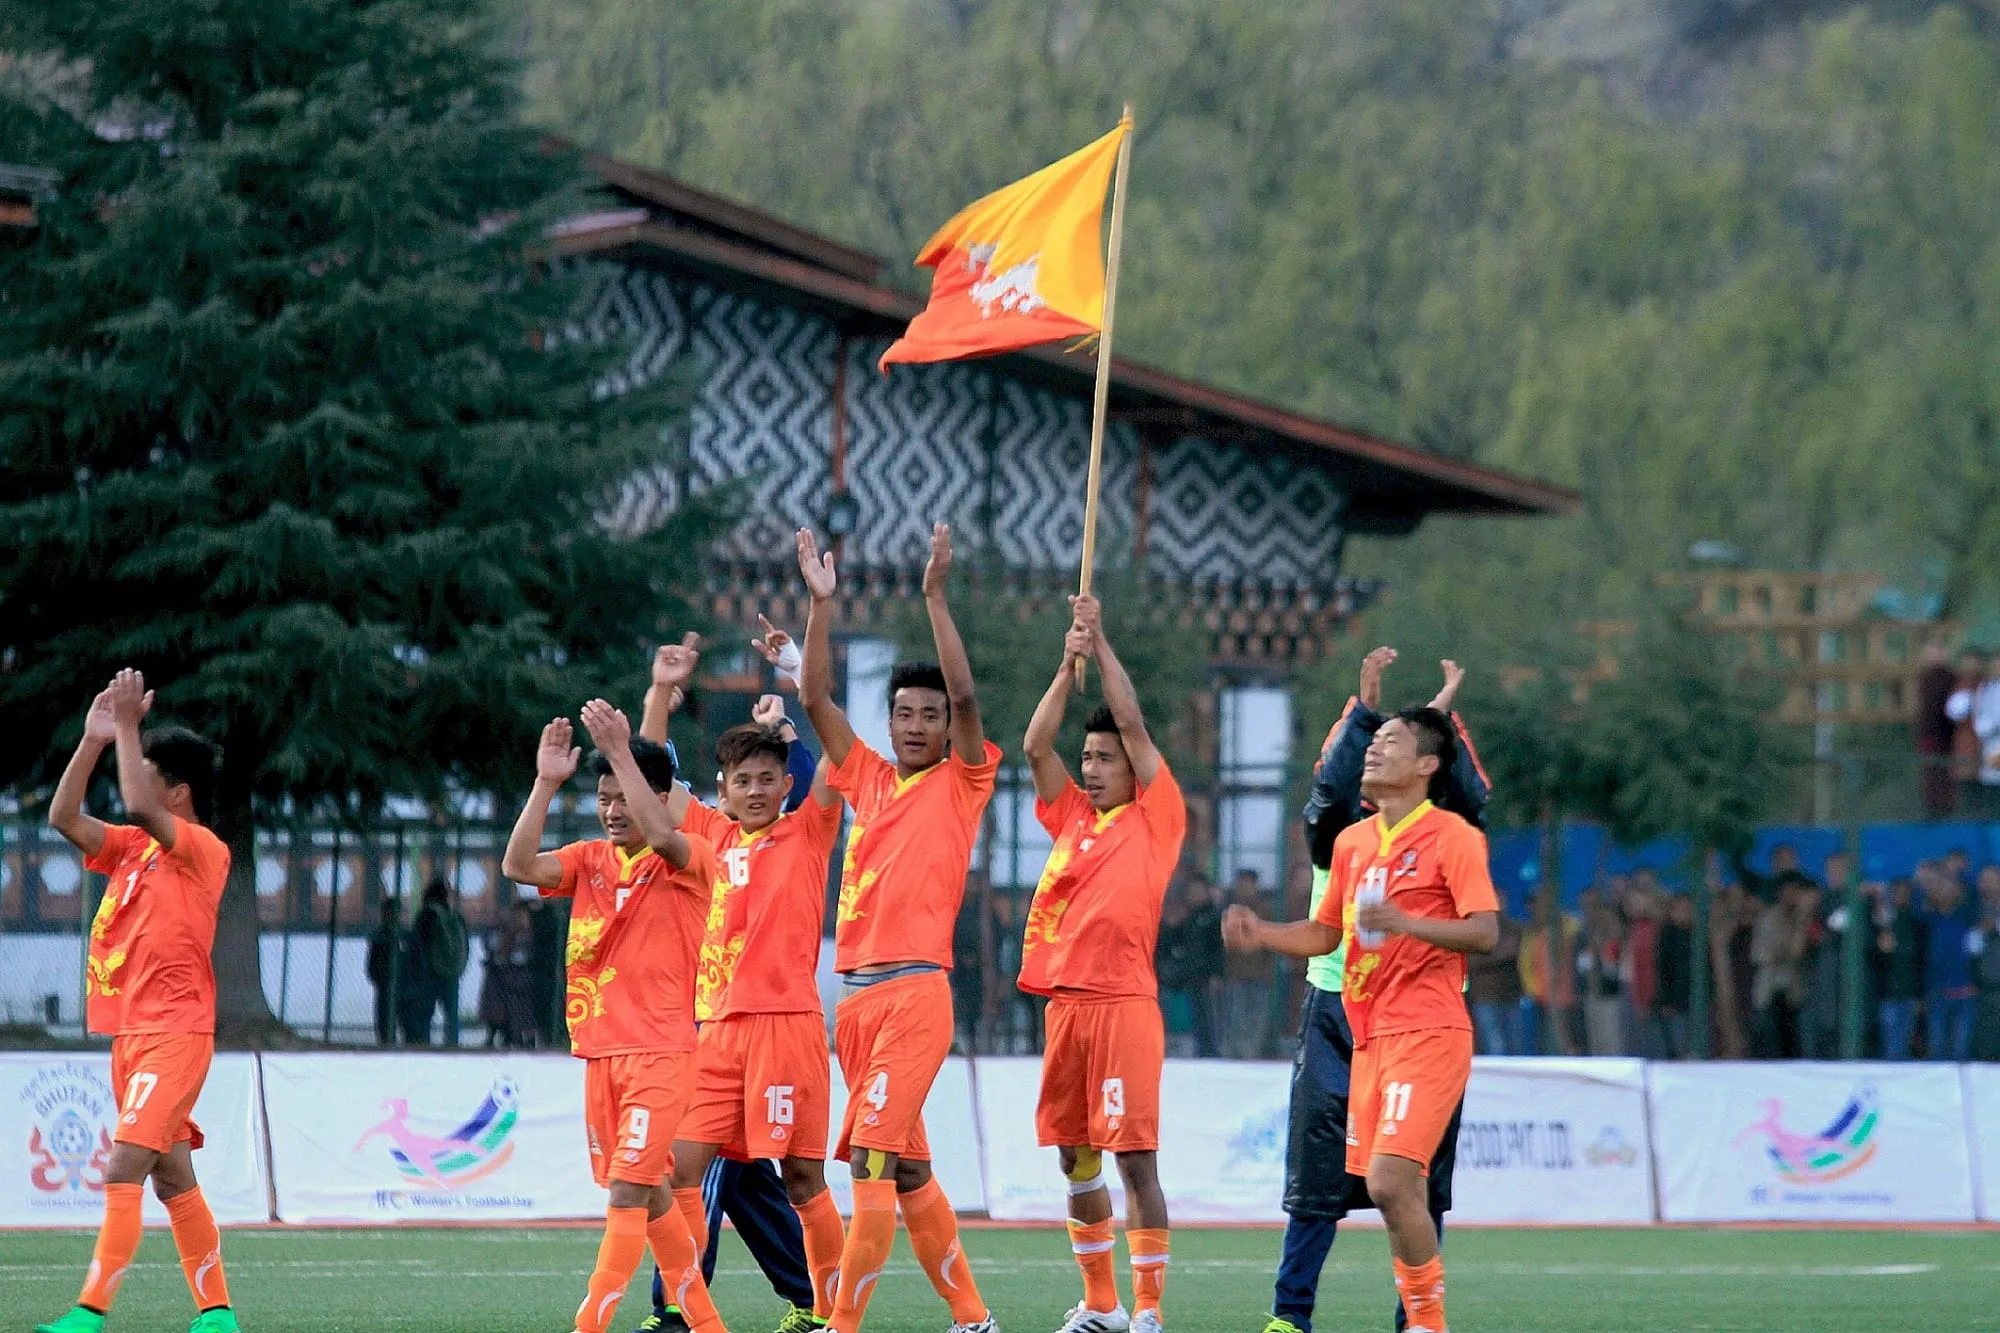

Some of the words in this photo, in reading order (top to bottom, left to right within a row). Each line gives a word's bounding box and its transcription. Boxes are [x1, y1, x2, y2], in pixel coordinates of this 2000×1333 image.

[723, 848, 750, 886] 16
[36, 1085, 103, 1118] BHUTAN
[126, 1071, 159, 1110] 17
[764, 1085, 794, 1124] 16
[867, 1071, 888, 1111] 4
[1101, 1078, 1125, 1116] 13
[1384, 1081, 1413, 1120] 11
[625, 1108, 650, 1149] 9
